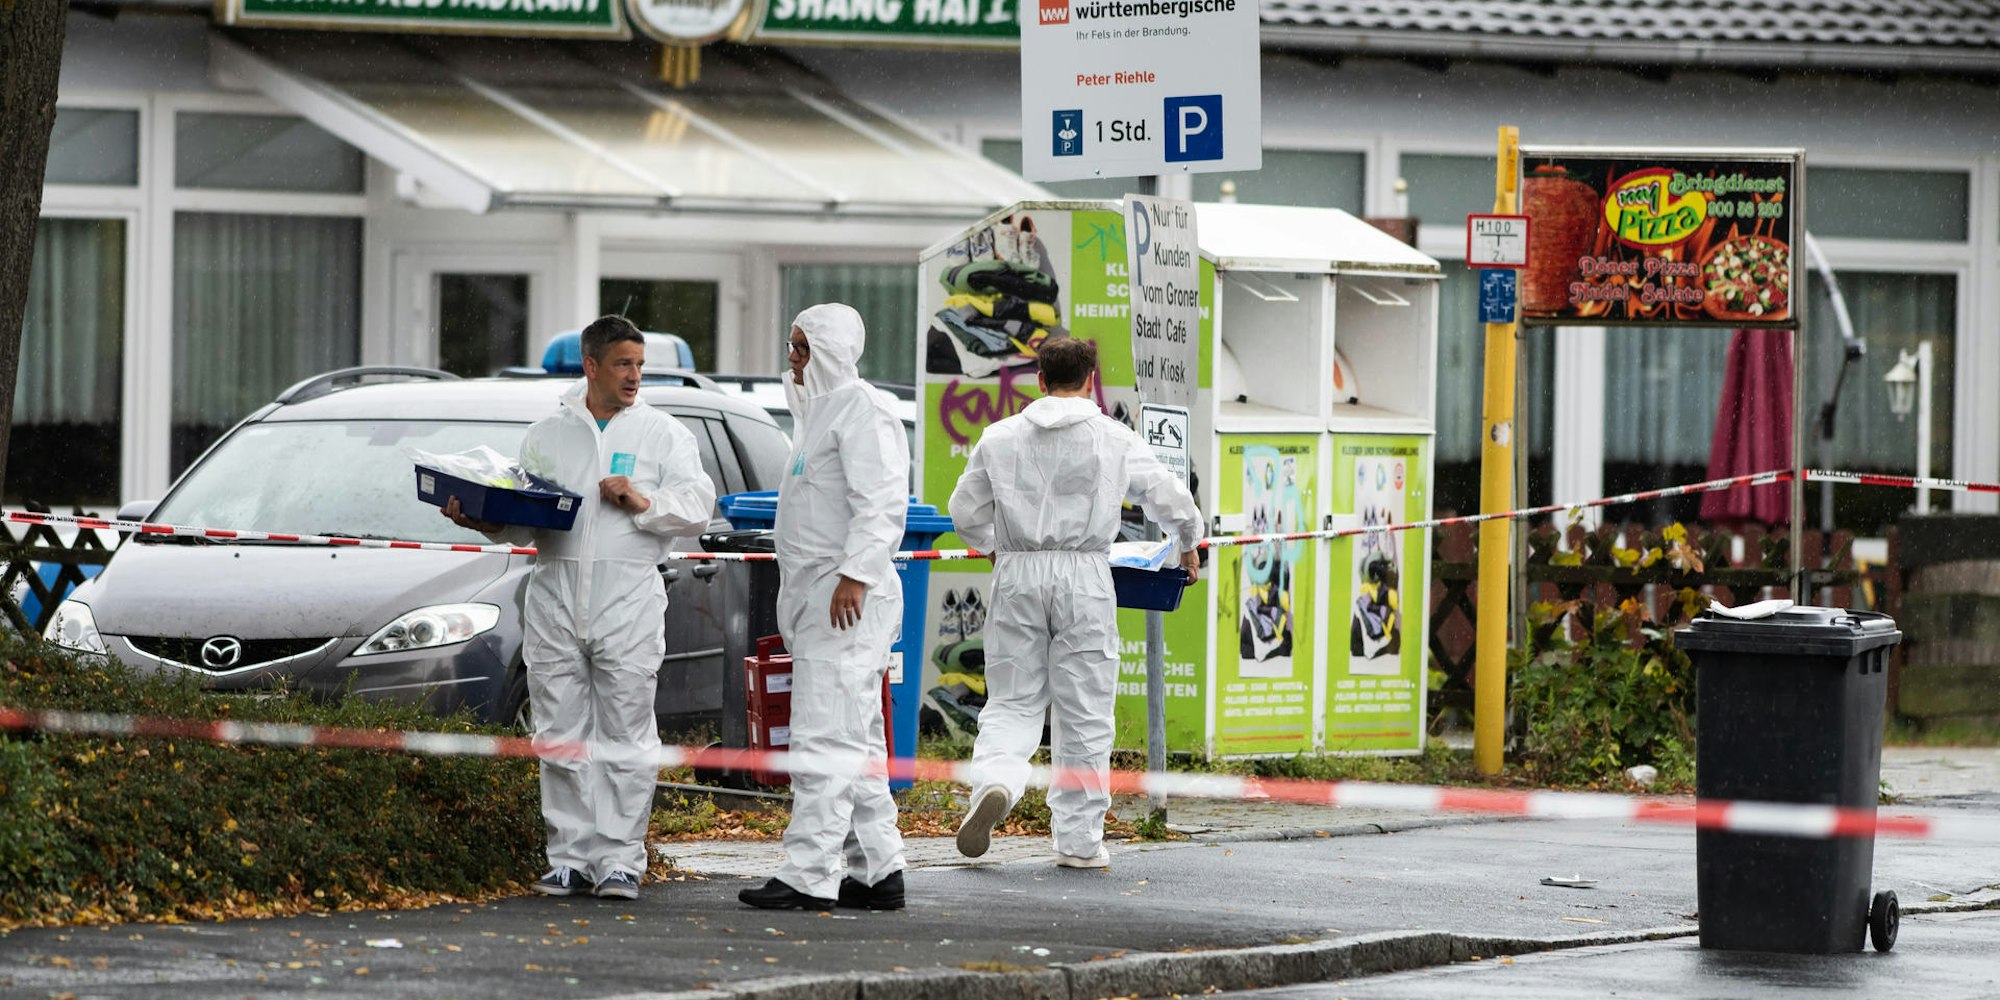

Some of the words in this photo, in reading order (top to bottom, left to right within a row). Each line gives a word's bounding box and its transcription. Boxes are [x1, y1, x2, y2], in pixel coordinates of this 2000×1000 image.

[1076, 31, 1089, 41] Ihr
[1091, 30, 1111, 40] Fels
[1113, 30, 1122, 38] in
[1124, 29, 1140, 38] der
[1142, 26, 1191, 38] Brandung.
[1076, 74, 1111, 86] Peter
[1114, 71, 1156, 84] Riehle
[1096, 121, 1103, 142] 1
[1110, 119, 1152, 141] Std.
[1178, 105, 1208, 153] P
[1669, 172, 1785, 195] Bringdienst
[1153, 204, 1171, 226] Nur
[1174, 205, 1188, 229] für
[1617, 206, 1700, 240] Pizza
[1132, 201, 1151, 286] P
[1154, 242, 1191, 268] Kunden
[1578, 255, 1639, 276] Döner
[1643, 257, 1699, 278] Pizza
[1142, 286, 1164, 305] vom
[1166, 282, 1199, 307] Groner
[1570, 282, 1630, 302] Nudel
[1641, 282, 1704, 302] Salate
[1136, 313, 1161, 340] Stadt
[1166, 318, 1187, 344] Café
[1135, 355, 1154, 379] und
[1160, 357, 1185, 384] Kiosk
